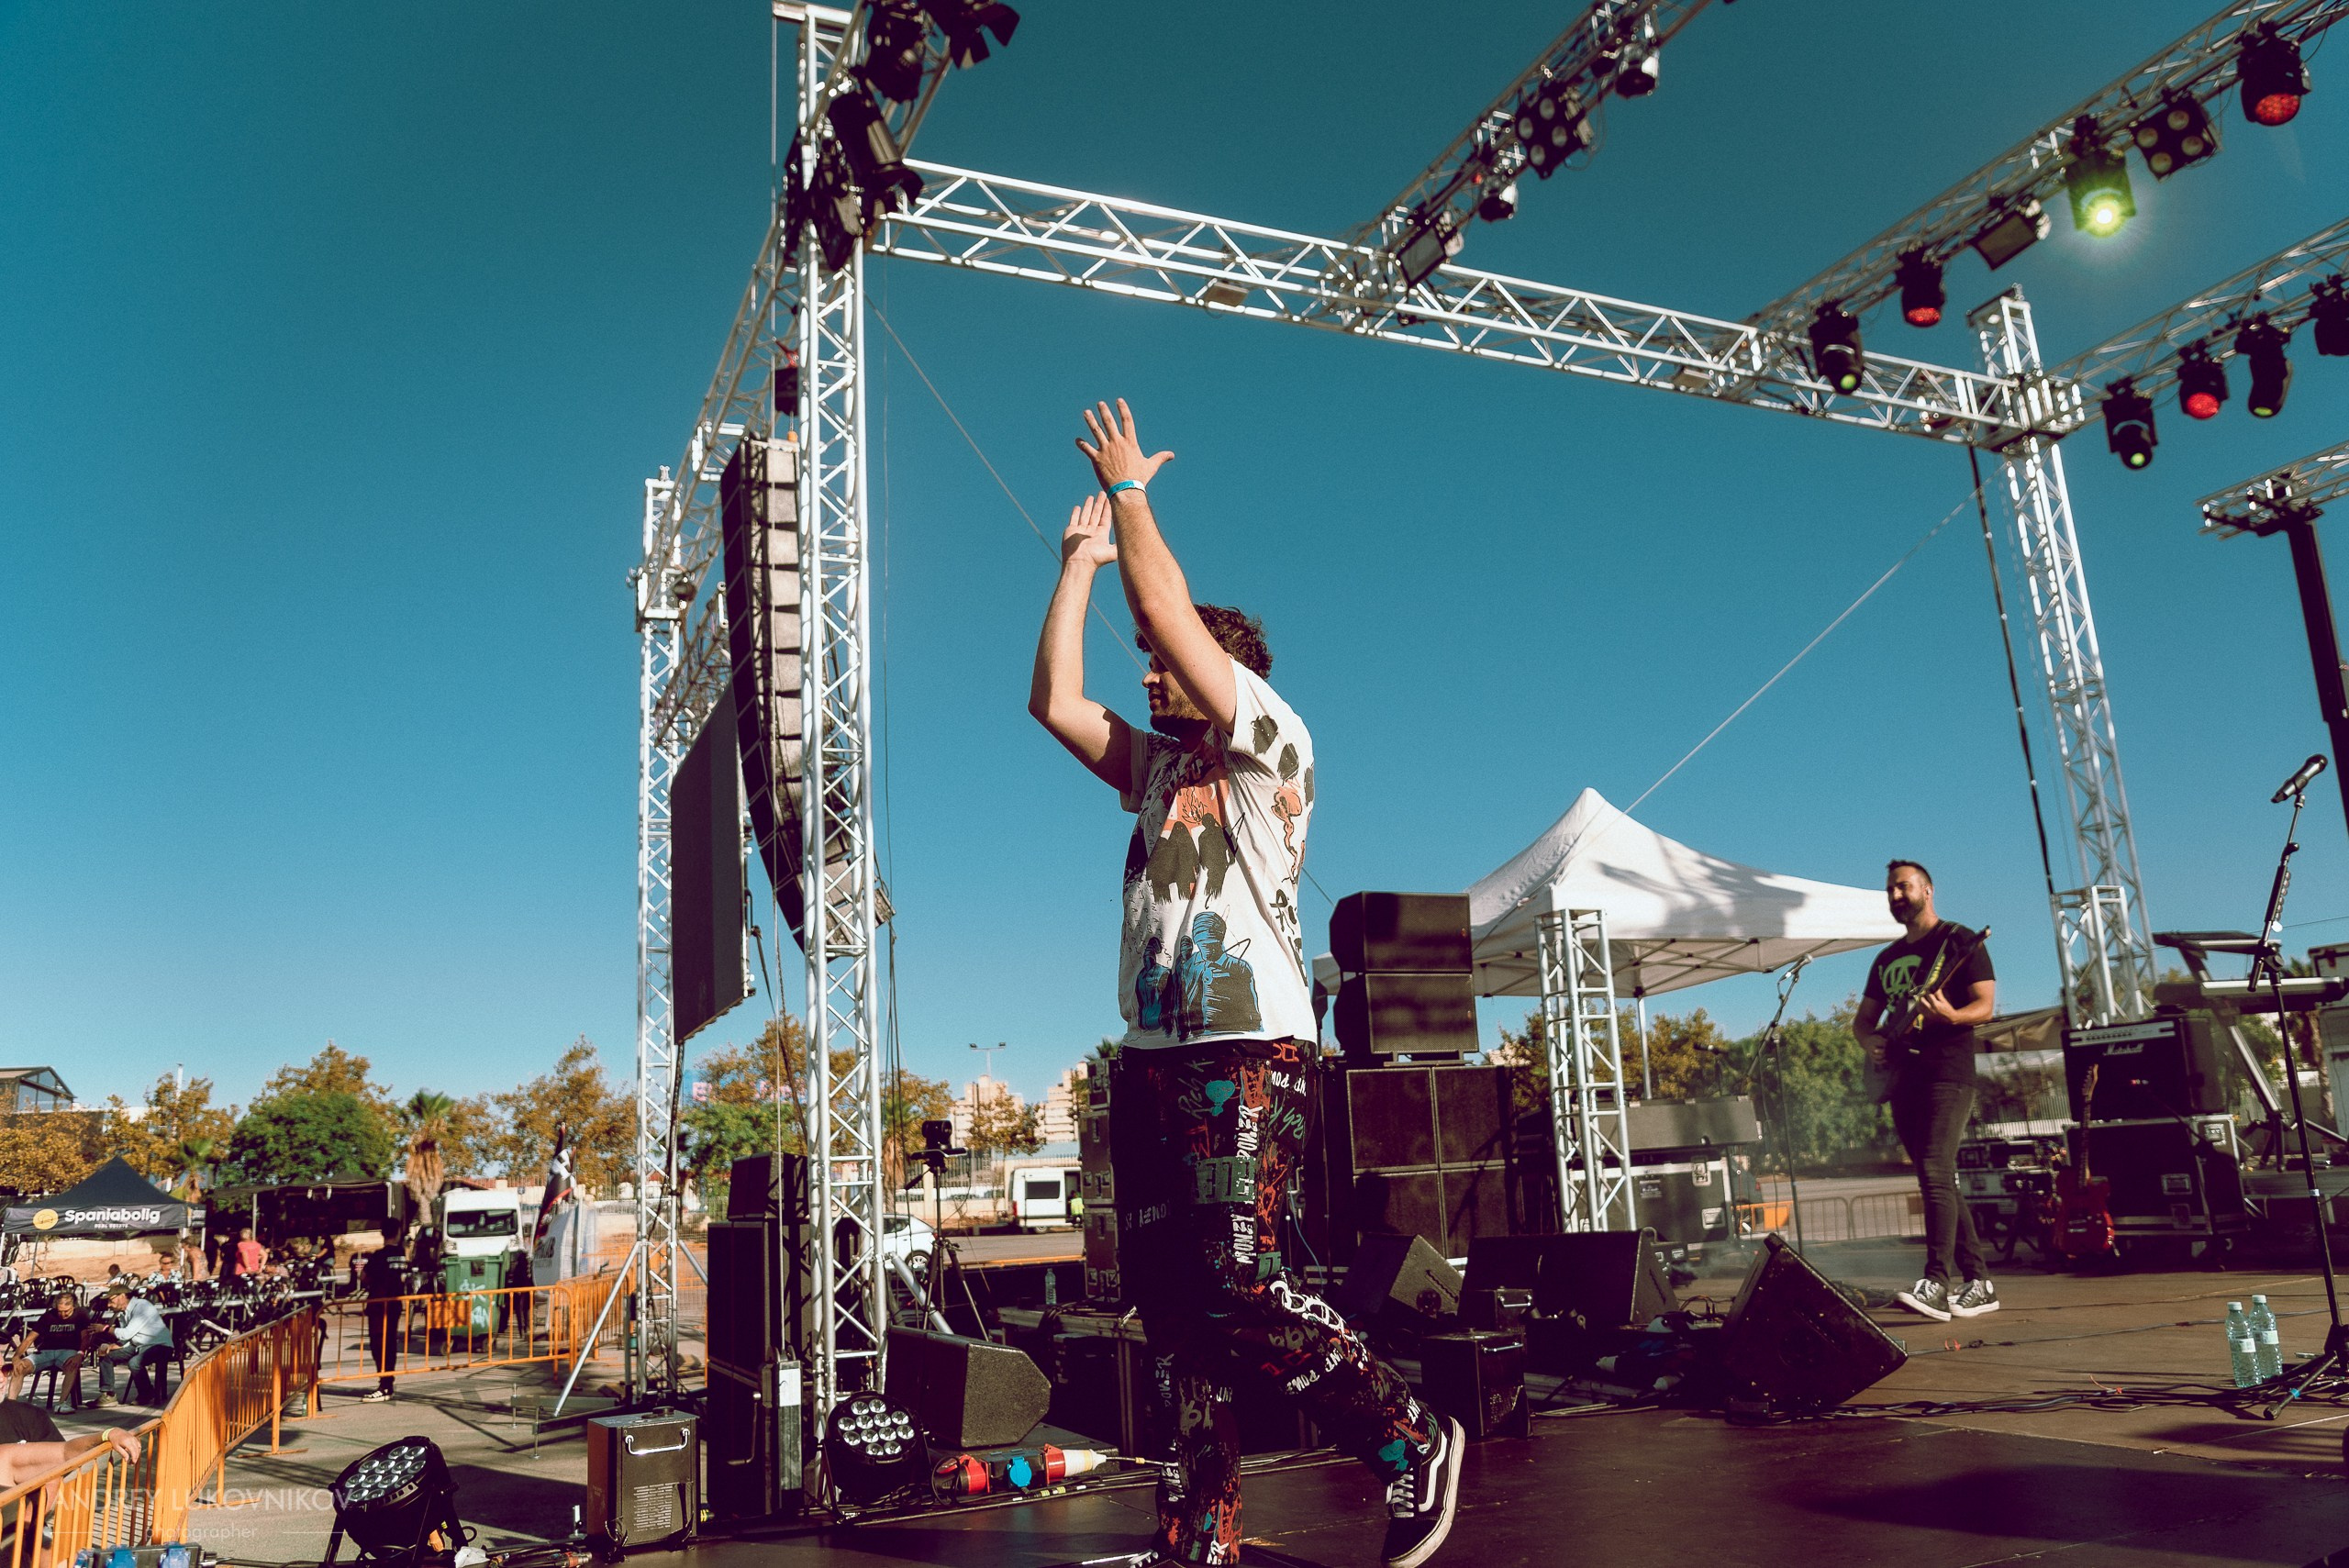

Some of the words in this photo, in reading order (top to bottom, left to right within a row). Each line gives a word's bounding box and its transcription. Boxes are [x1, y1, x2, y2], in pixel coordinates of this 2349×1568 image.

[2101, 1041, 2144, 1057] Marshall
[1235, 1105, 1264, 1160] POWER
[64, 1207, 161, 1225] Spaniabolig
[1230, 1213, 1257, 1264] MONEY
